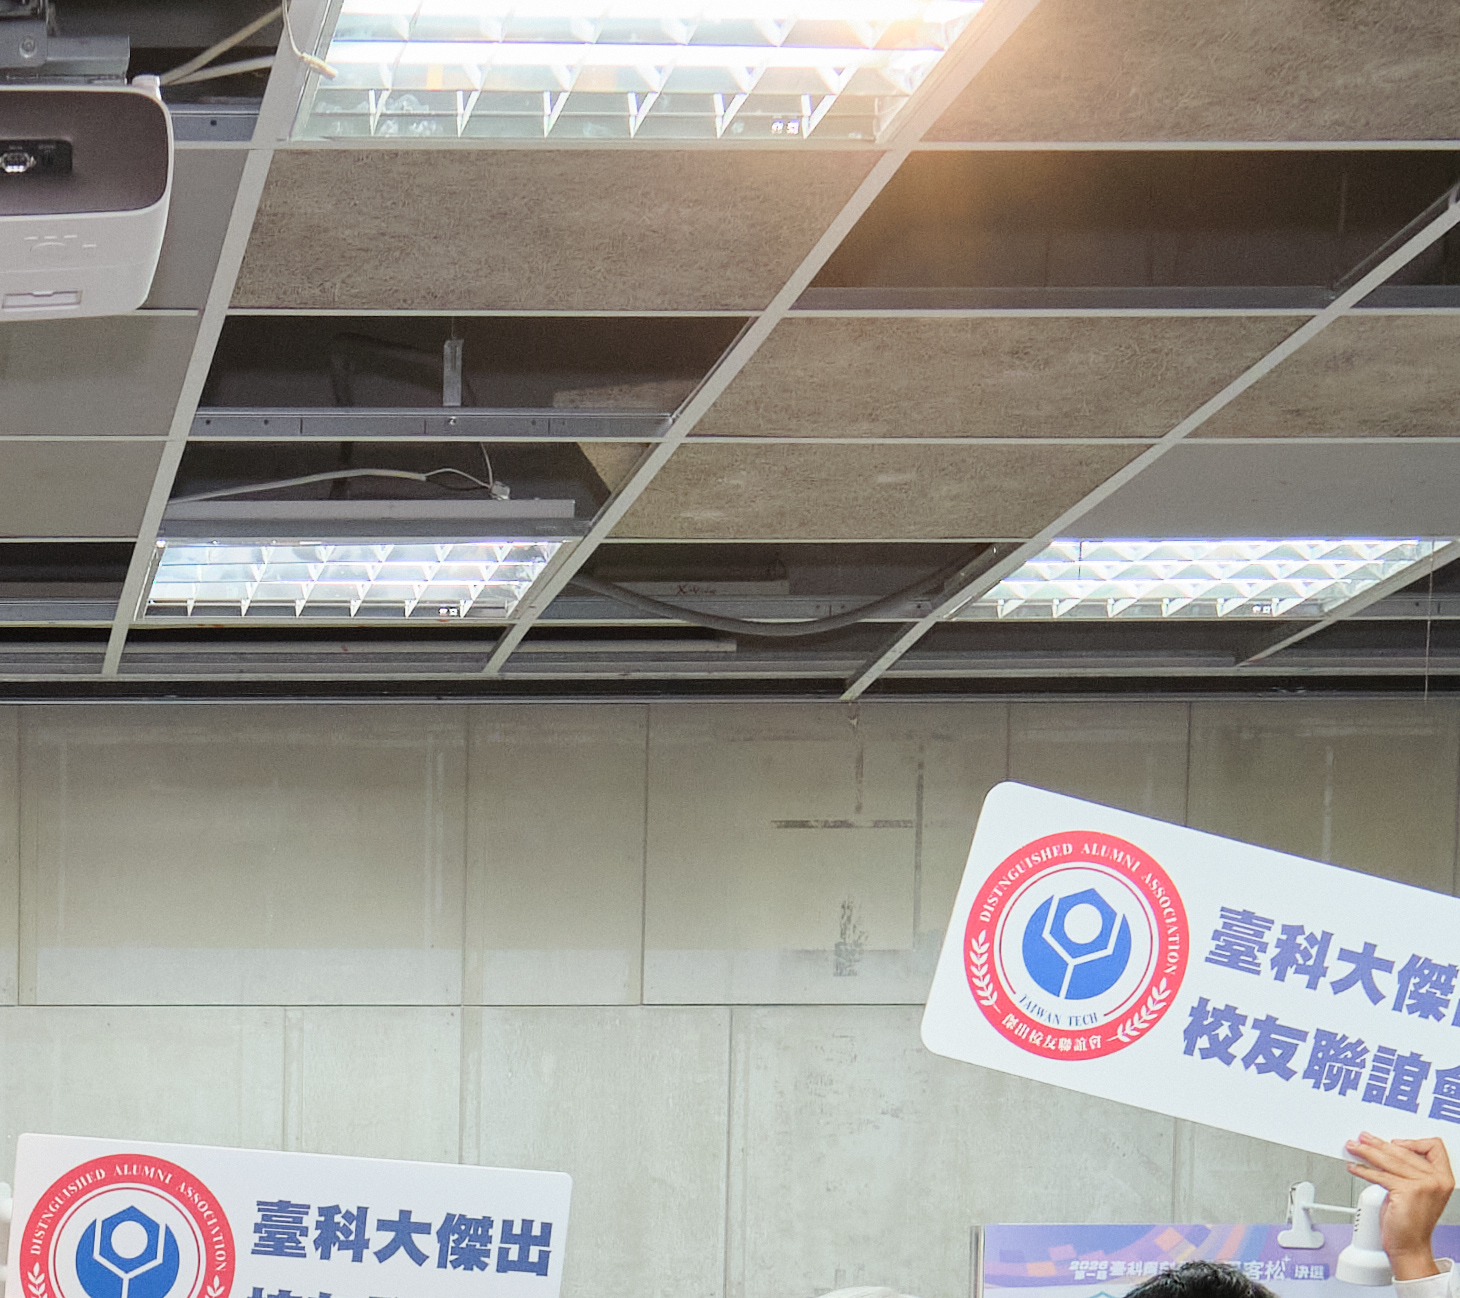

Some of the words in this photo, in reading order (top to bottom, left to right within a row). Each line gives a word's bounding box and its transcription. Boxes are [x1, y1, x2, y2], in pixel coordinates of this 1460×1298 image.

[1081, 843, 1141, 873] ALUMNI
[1141, 872, 1180, 976] ASSOCIATION
[1019, 994, 1062, 1026] TAIWAN
[1067, 1012, 1099, 1027] TECH
[114, 1164, 173, 1184] ALUMNI
[178, 1182, 227, 1272] ASSOCIATION
[250, 1199, 553, 1278] 臺科大傑出
[1069, 1260, 1109, 1270] 2026
